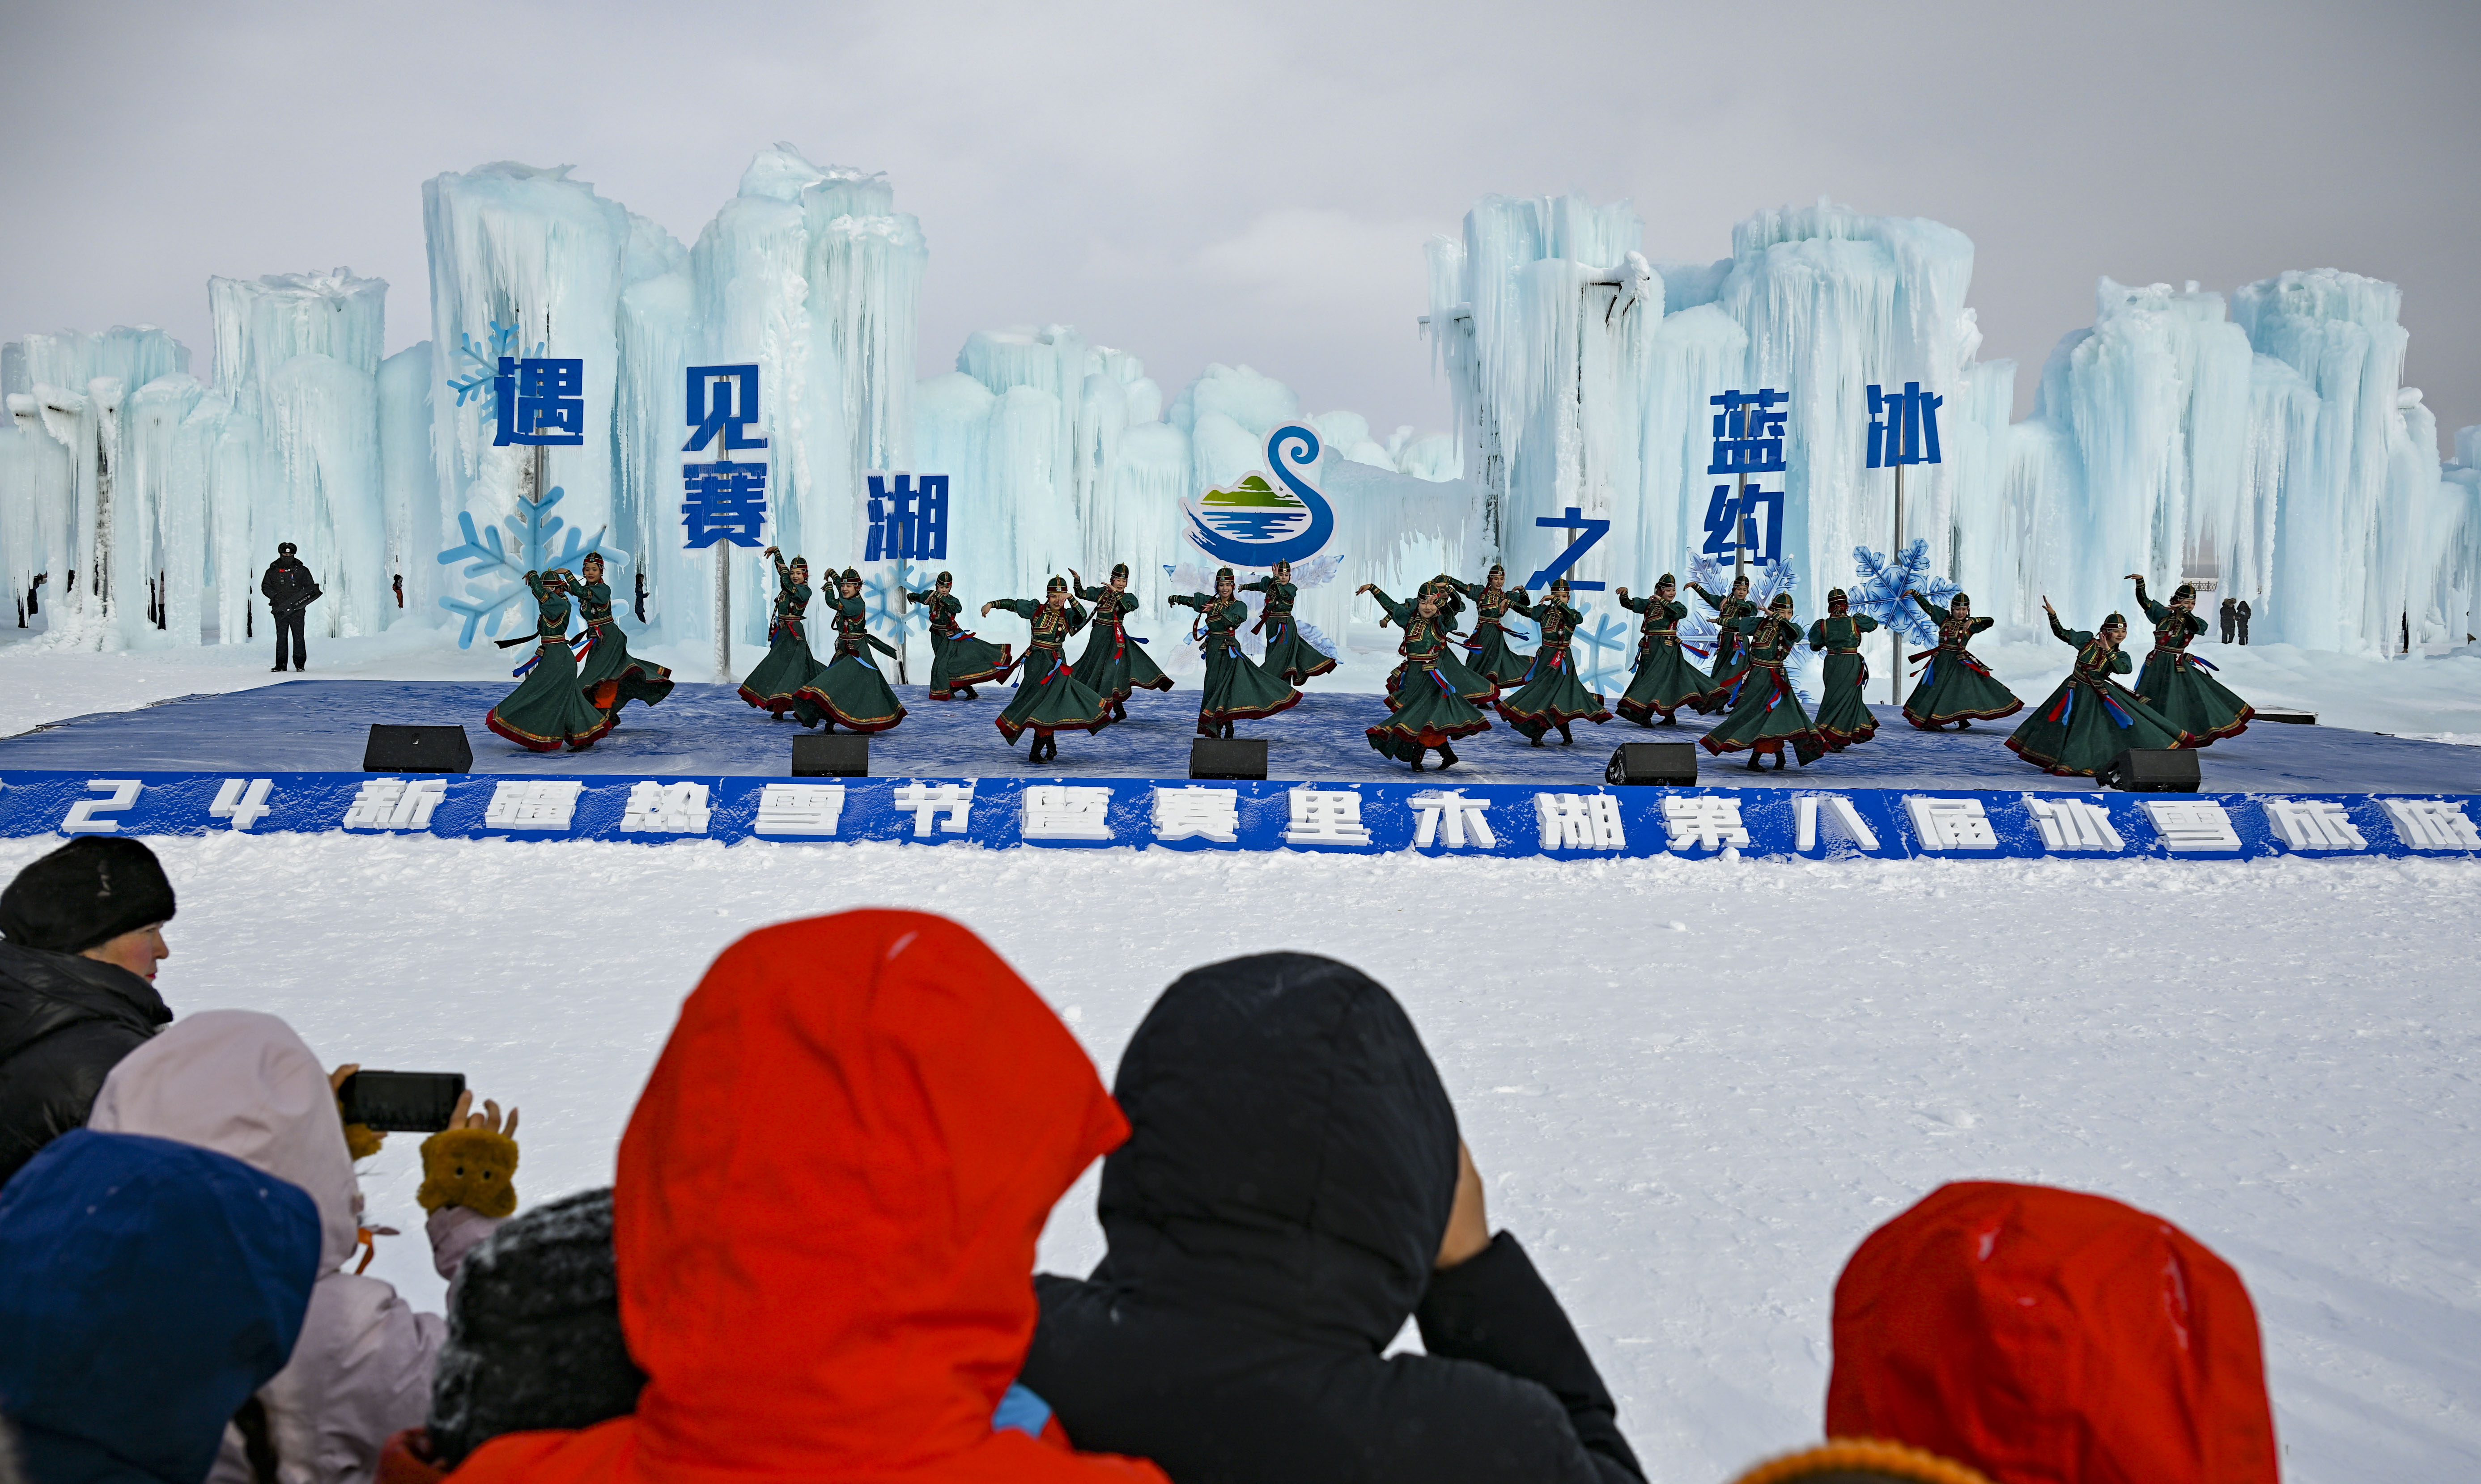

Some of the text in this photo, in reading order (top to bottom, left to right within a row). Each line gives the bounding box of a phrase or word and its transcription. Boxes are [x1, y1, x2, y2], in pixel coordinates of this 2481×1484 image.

[0, 776, 2481, 851] 24新疆热雪节暨赛里木湖第八届冰雪旅游
